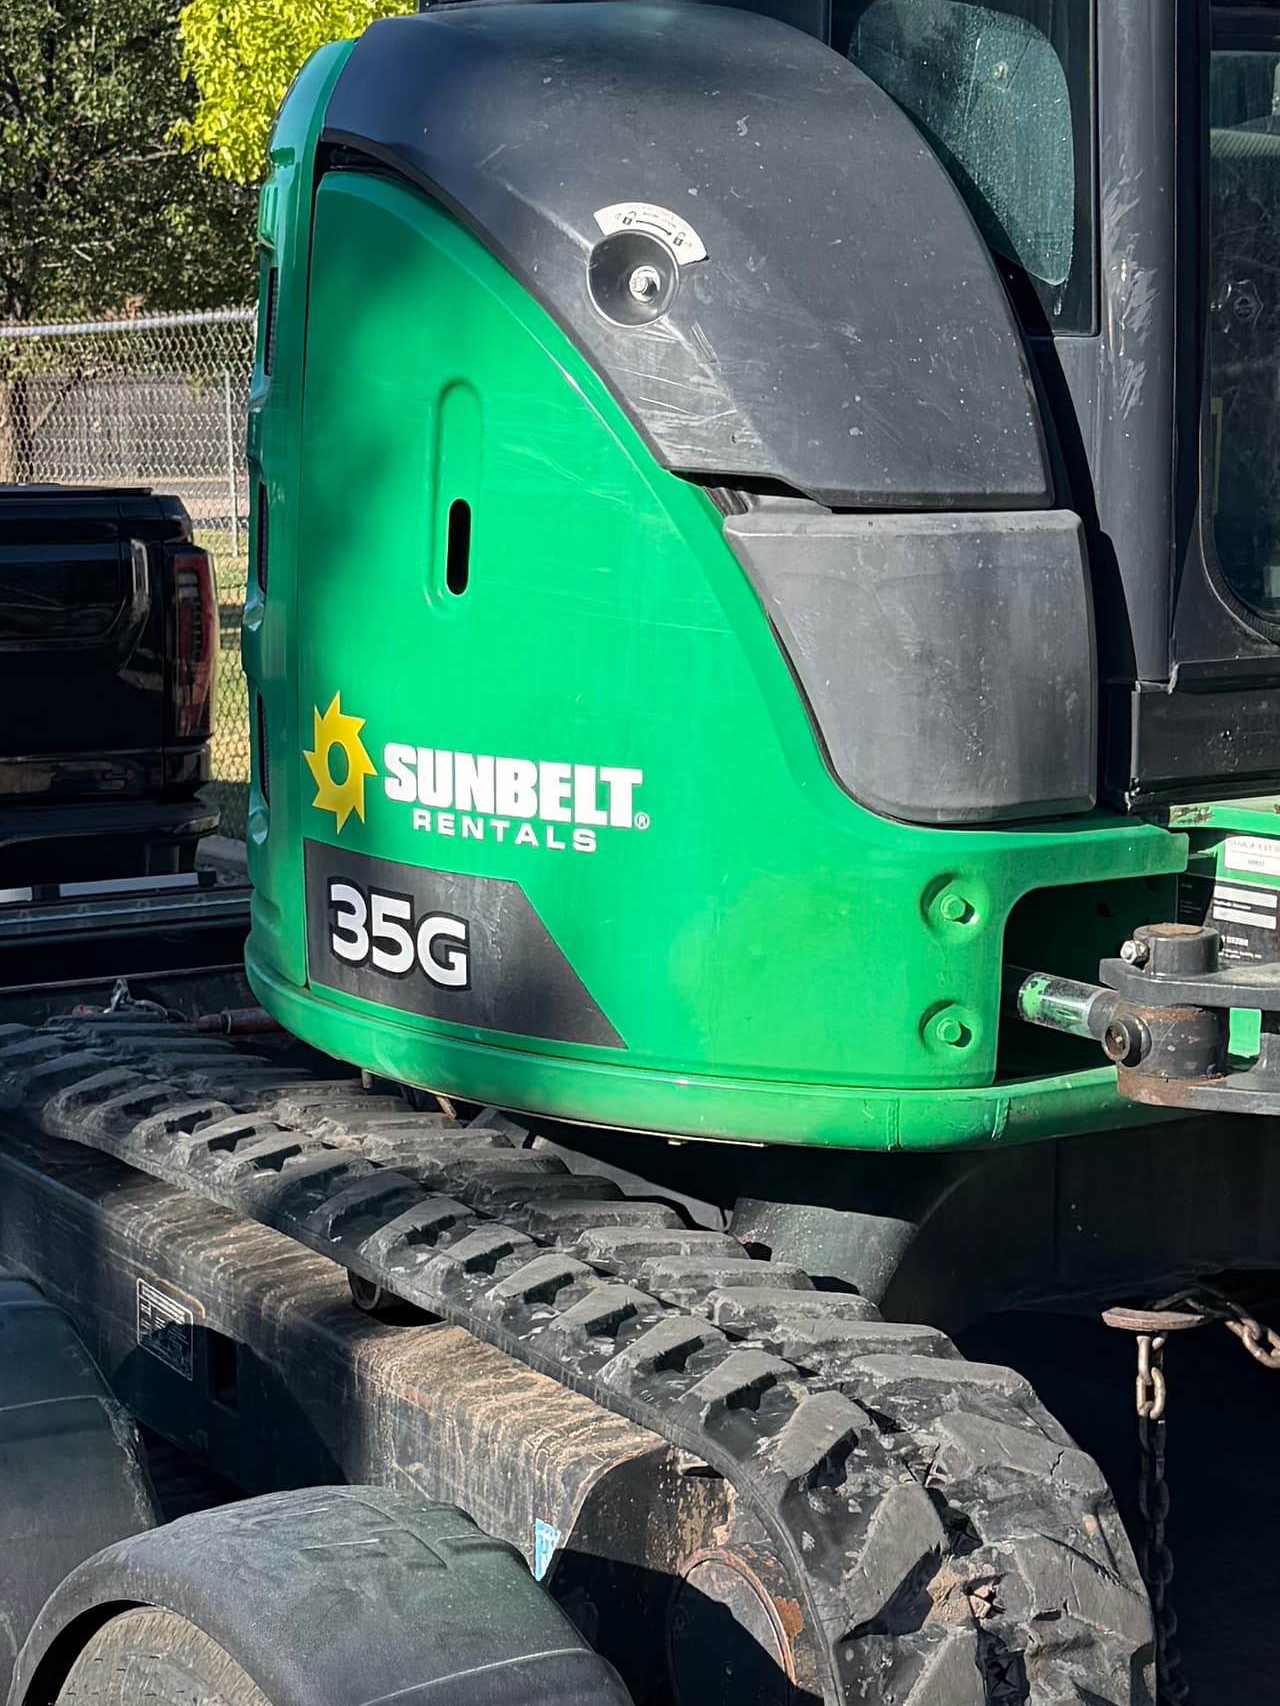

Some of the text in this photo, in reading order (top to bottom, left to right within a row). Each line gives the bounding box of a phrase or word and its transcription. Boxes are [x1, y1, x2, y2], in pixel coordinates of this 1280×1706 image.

[383, 741, 644, 829] SUNBELT
[411, 807, 598, 853] RENTALS
[329, 881, 469, 989] 35G
